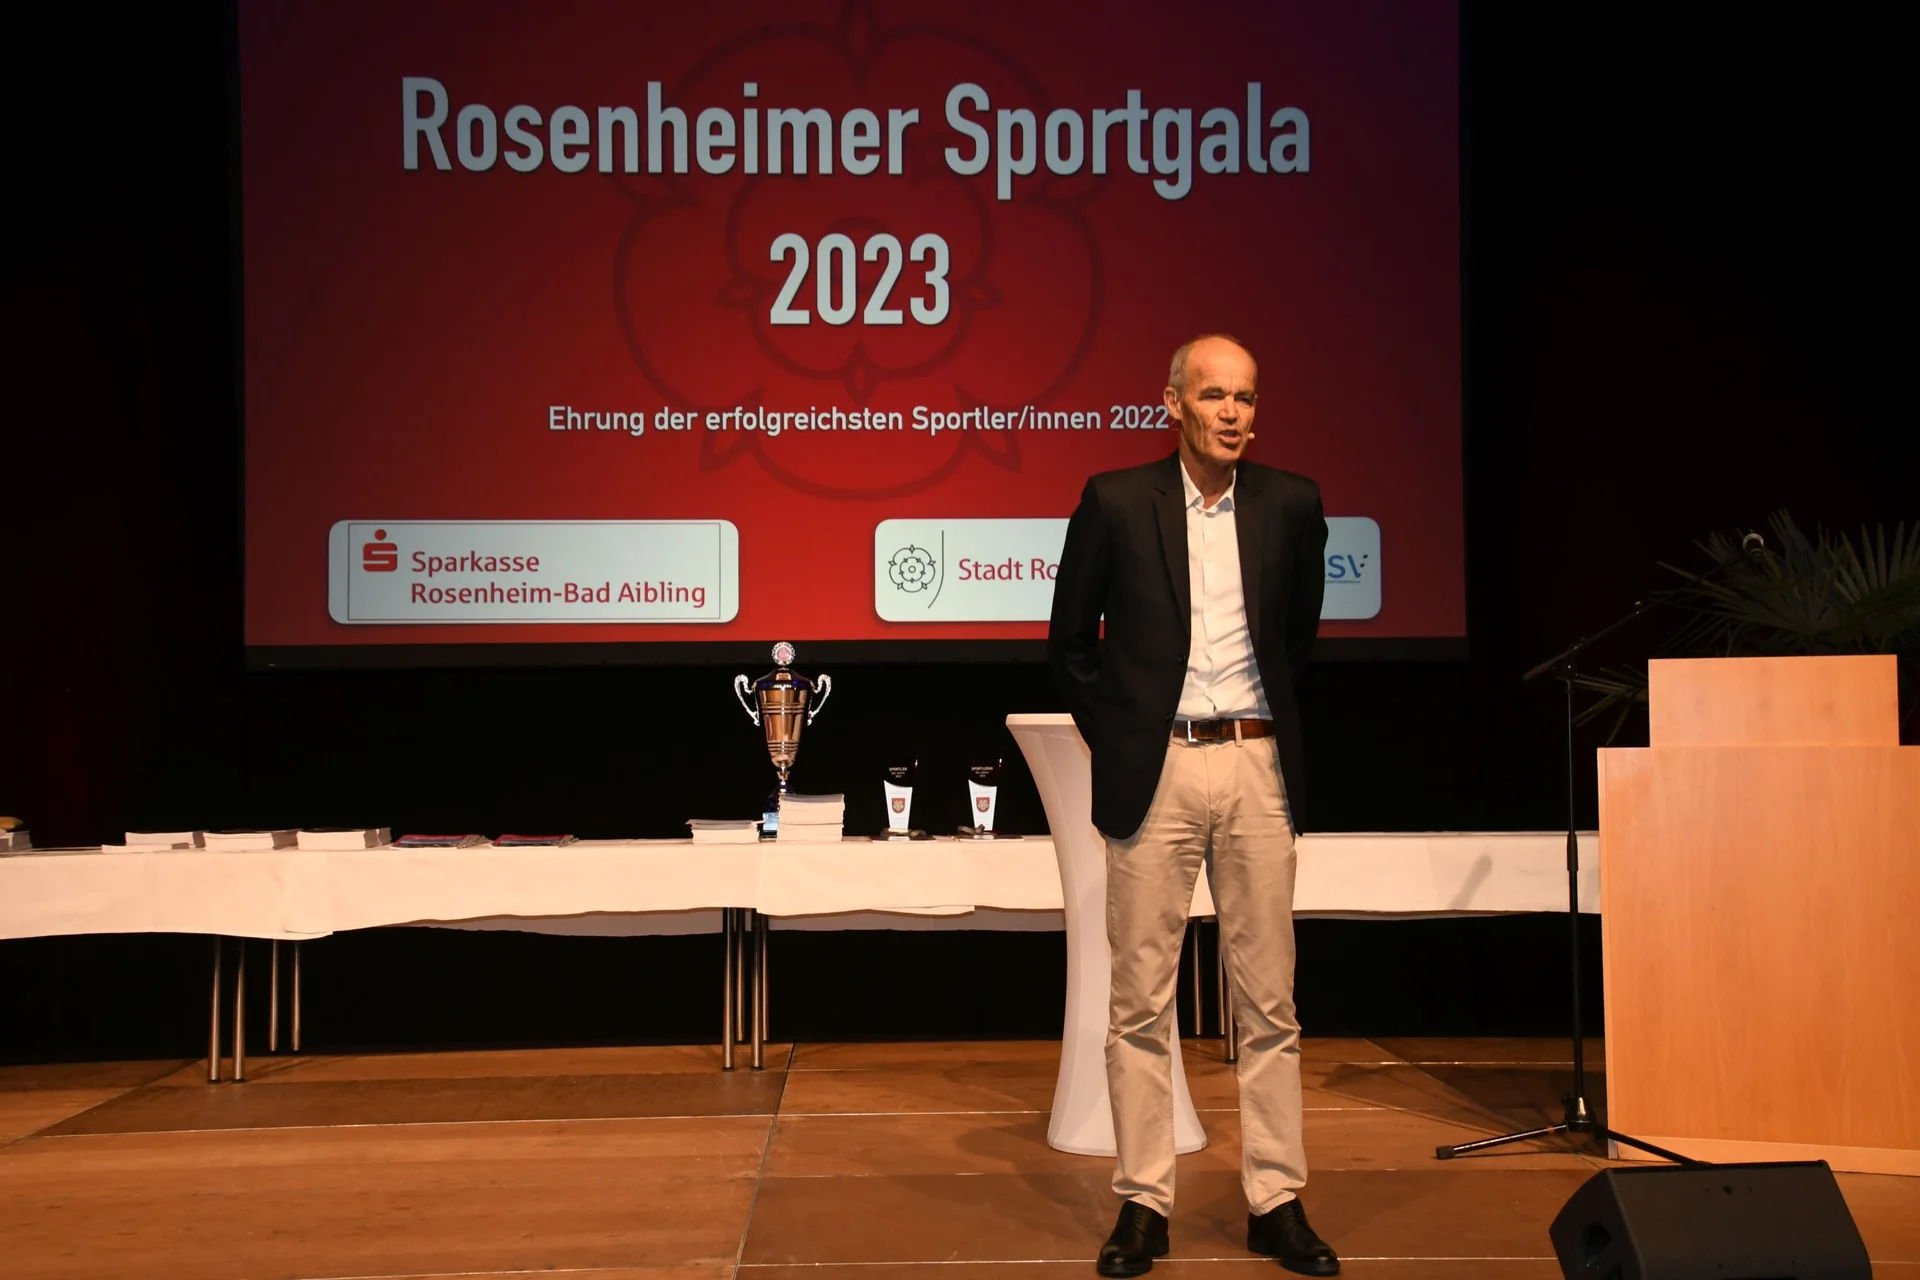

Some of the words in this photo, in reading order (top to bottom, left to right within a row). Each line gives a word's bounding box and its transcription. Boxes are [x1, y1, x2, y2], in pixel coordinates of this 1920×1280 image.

[403, 77, 919, 176] Rosenheimer
[944, 82, 1311, 200] Sportgala
[770, 233, 950, 325] 2023
[549, 405, 645, 437] Ehrung
[654, 405, 699, 431] der
[705, 405, 903, 437] erfolgreichsten
[911, 405, 1101, 437] Sportler/innen
[1110, 404, 1169, 430] 2022
[411, 550, 540, 577] Sparkasse
[958, 557, 1024, 581] Stadt
[411, 581, 610, 605] Rosenheim-Bad
[617, 581, 706, 608] Aibling
